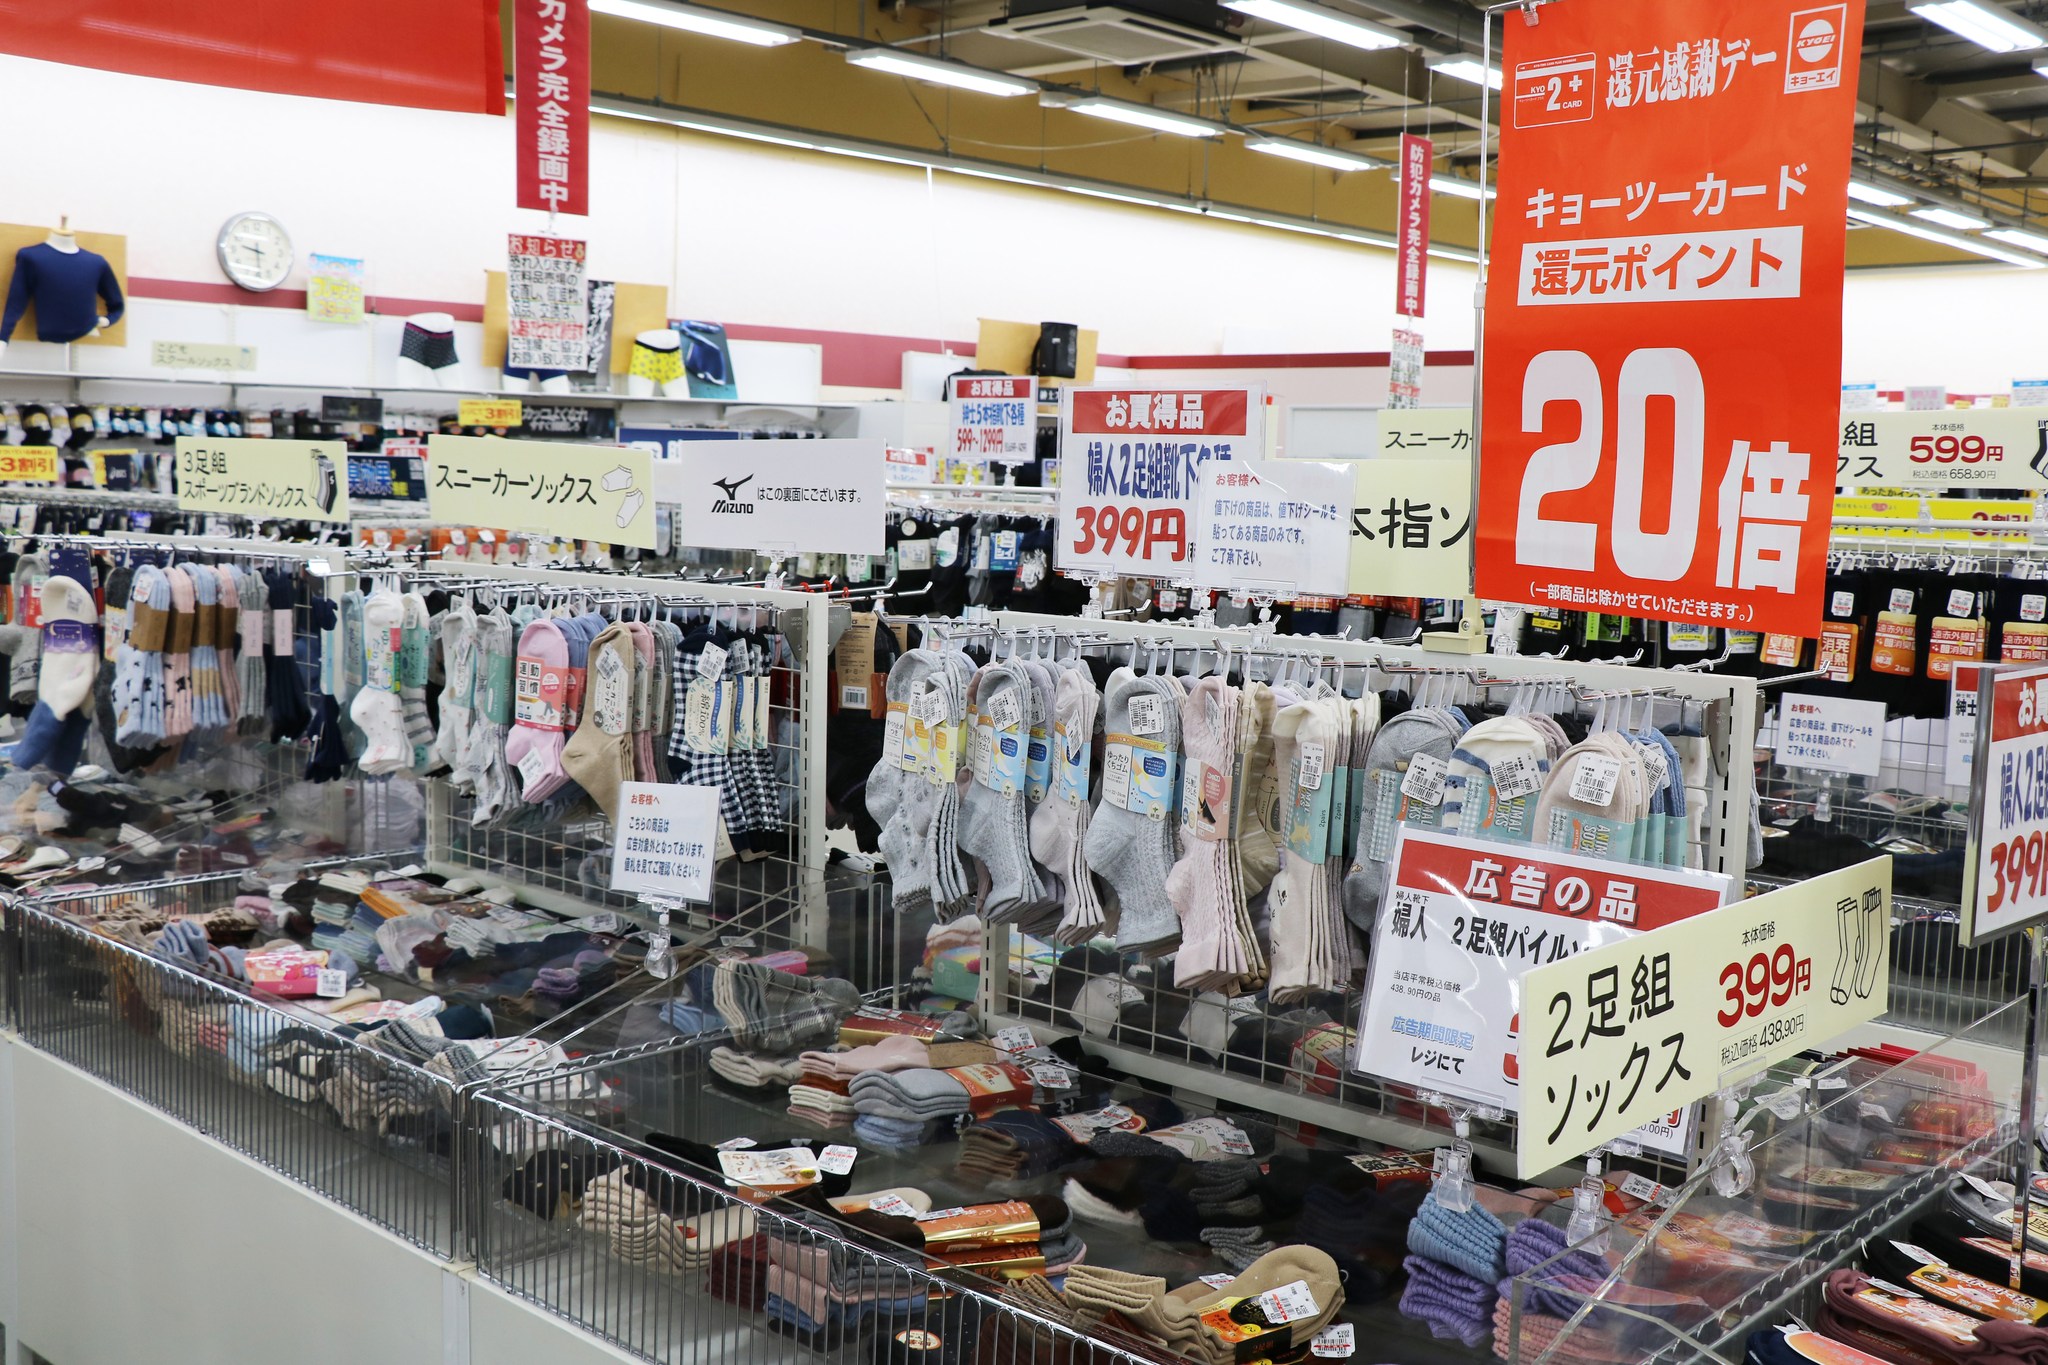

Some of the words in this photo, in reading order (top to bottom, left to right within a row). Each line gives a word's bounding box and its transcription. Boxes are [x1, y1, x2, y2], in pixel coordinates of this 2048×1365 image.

[1796, 34, 1836, 49] KYOEI
[1605, 38, 1777, 111] 還元感謝デー
[1790, 70, 1837, 88] キョーエイ
[1530, 85, 1546, 94] KYO
[1562, 100, 1583, 109] CARD
[1525, 163, 1808, 228] キョーツーカード
[1405, 143, 1425, 315] 防犯カメラ完全録画中
[509, 236, 574, 258] お知らせ
[1530, 238, 1783, 298] 還元ポイント
[970, 380, 1015, 397] お買得品
[1106, 393, 1204, 430] お買得品
[1385, 428, 1473, 450] スニーカ
[1931, 423, 1965, 432] 本体価格
[1909, 435, 2004, 463] 599円
[184, 449, 228, 475] 3足組
[1087, 441, 1233, 501] 婦人2足組靴下
[1515, 347, 1811, 595] 20倍
[436, 464, 598, 506] スニーカーソックス
[1216, 473, 1260, 487] お客様へ
[1912, 470, 1948, 479] 税込価格
[1949, 468, 1997, 480] 658.90円
[184, 477, 308, 508] スポーツブランドソックス
[757, 487, 862, 504] はこの裏面にございます。
[1214, 499, 1337, 522] 値下げの商品は、値下げシールを
[1073, 505, 1187, 563] 399円
[1212, 523, 1305, 546] 貼ってある商品のみです。
[1211, 547, 1263, 567] ご了承下さい。
[1791, 703, 1822, 714] お客様へ
[1955, 698, 1976, 717] 紳士
[1788, 731, 1857, 749] 貼ってある商品のみです。
[1107, 750, 1129, 764] ゆったり
[1787, 745, 1831, 760] ご了承ください。
[1106, 760, 1129, 773] くちゴム
[631, 793, 660, 806] お客様へ
[628, 816, 670, 833] こちらの商品は
[1507, 798, 1526, 833] NIMAL
[626, 837, 706, 859] 広告対象外となっております。
[1395, 891, 1430, 904] 婦人靴下
[1463, 857, 1638, 925] 広告の品
[1390, 902, 1428, 942] 婦人
[1741, 920, 1776, 947] 本体価格
[1390, 983, 1441, 1003] 438.90円の品
[1393, 969, 1461, 994] 当店平常税込価格
[1717, 943, 1812, 1028] 399円
[1546, 952, 1675, 1059] 2足組
[1391, 1015, 1475, 1051] 広告期間限定
[1721, 1034, 1758, 1066] 税込価格
[1760, 1012, 1805, 1048] 438.90円
[1411, 1046, 1465, 1075] レジにて
[1546, 1032, 1691, 1146] ソックス
